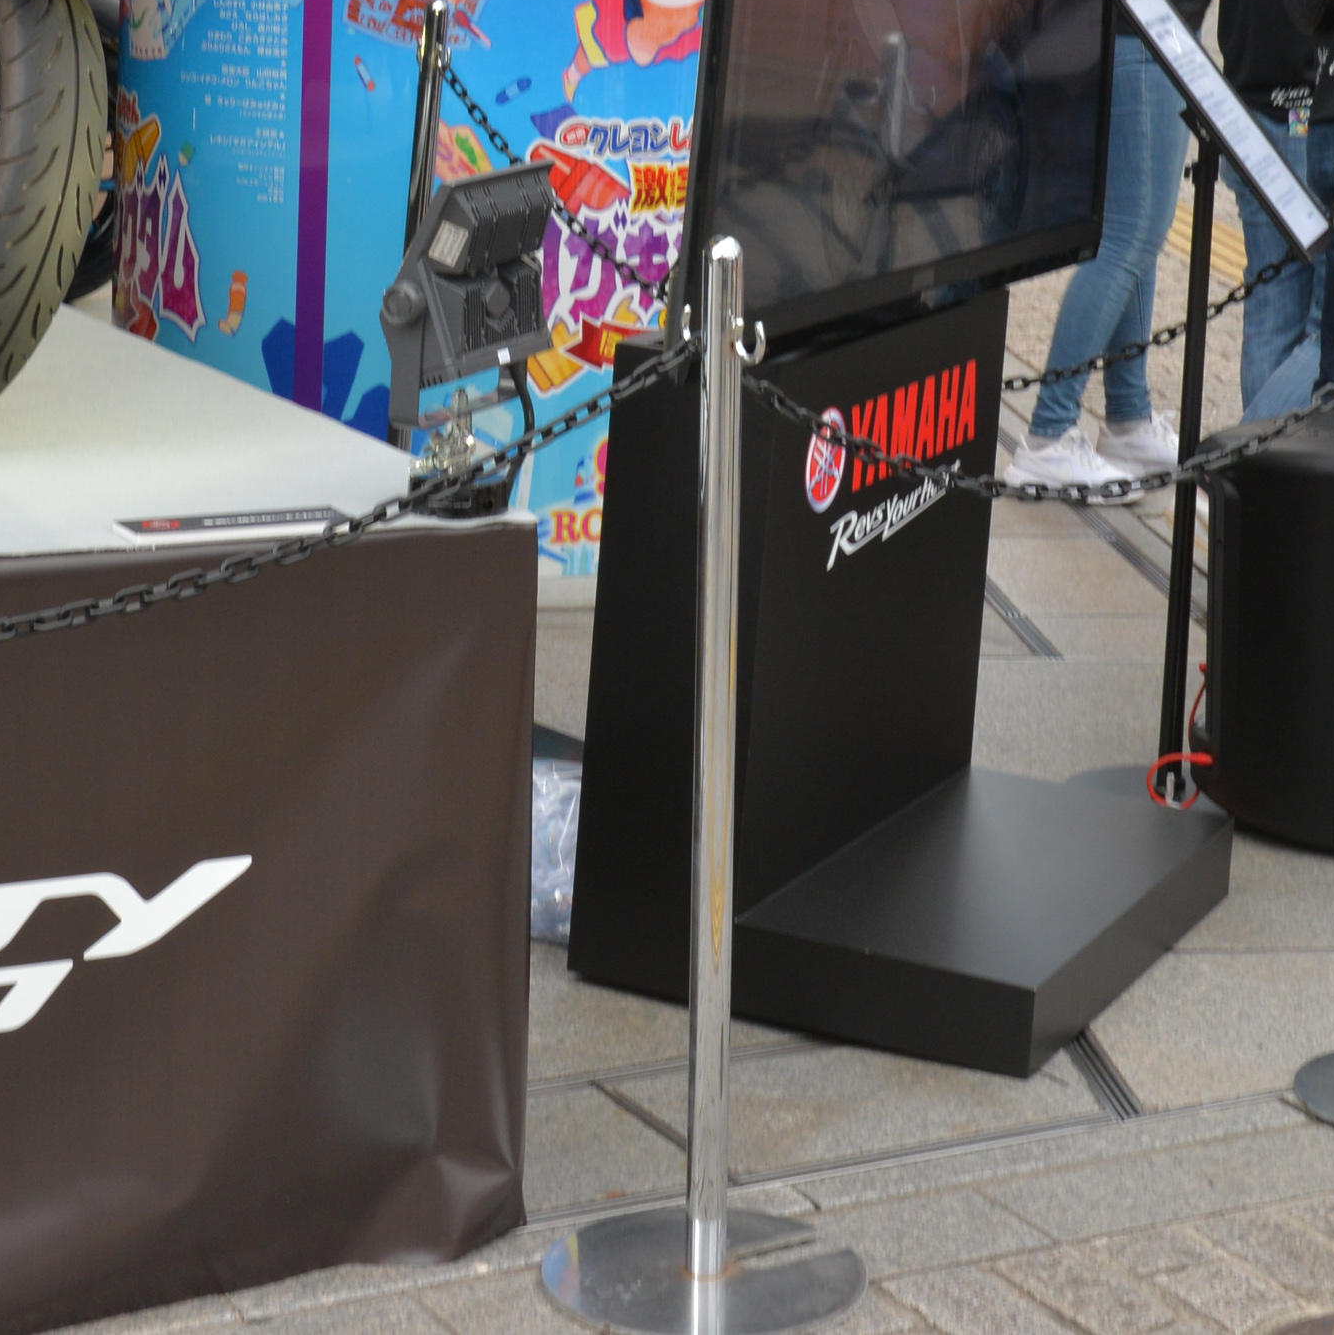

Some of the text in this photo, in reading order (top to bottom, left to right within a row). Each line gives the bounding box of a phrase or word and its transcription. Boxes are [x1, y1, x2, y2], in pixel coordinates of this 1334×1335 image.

[852, 358, 977, 494] YAMAHA
[827, 501, 886, 572] Revs
[882, 486, 922, 542] Your
